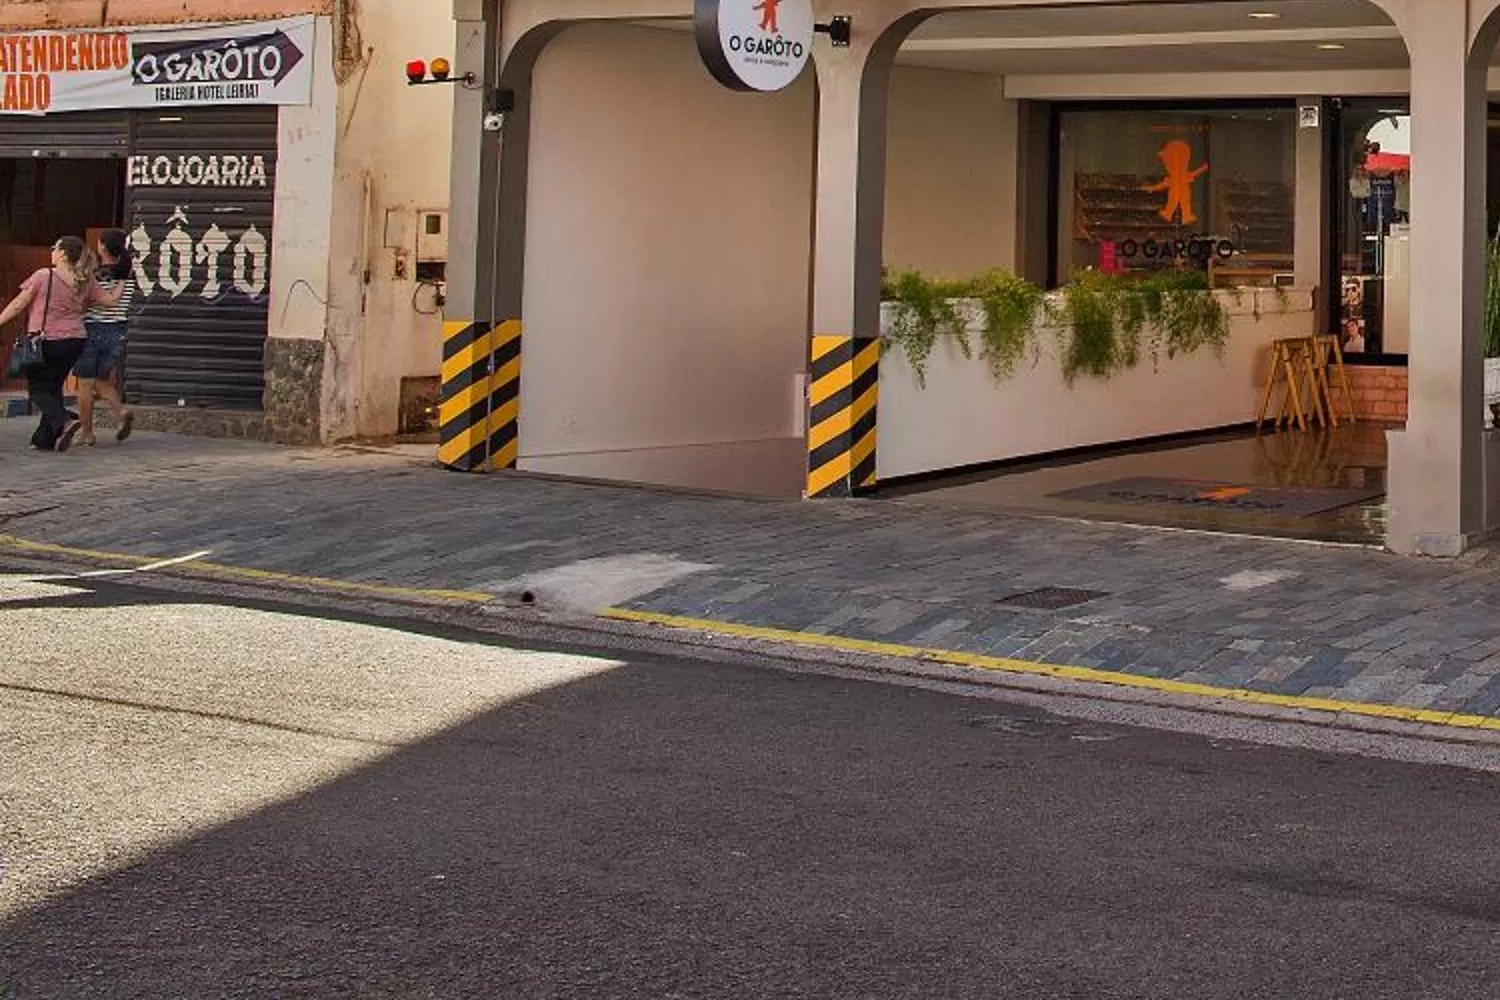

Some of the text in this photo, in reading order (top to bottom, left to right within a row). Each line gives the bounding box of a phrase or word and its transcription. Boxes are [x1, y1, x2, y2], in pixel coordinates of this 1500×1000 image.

[135, 40, 282, 83] O GARÔTO
[729, 34, 804, 59] O GARÔTO
[0, 73, 51, 111] ADO
[197, 84, 225, 101] HOTEL
